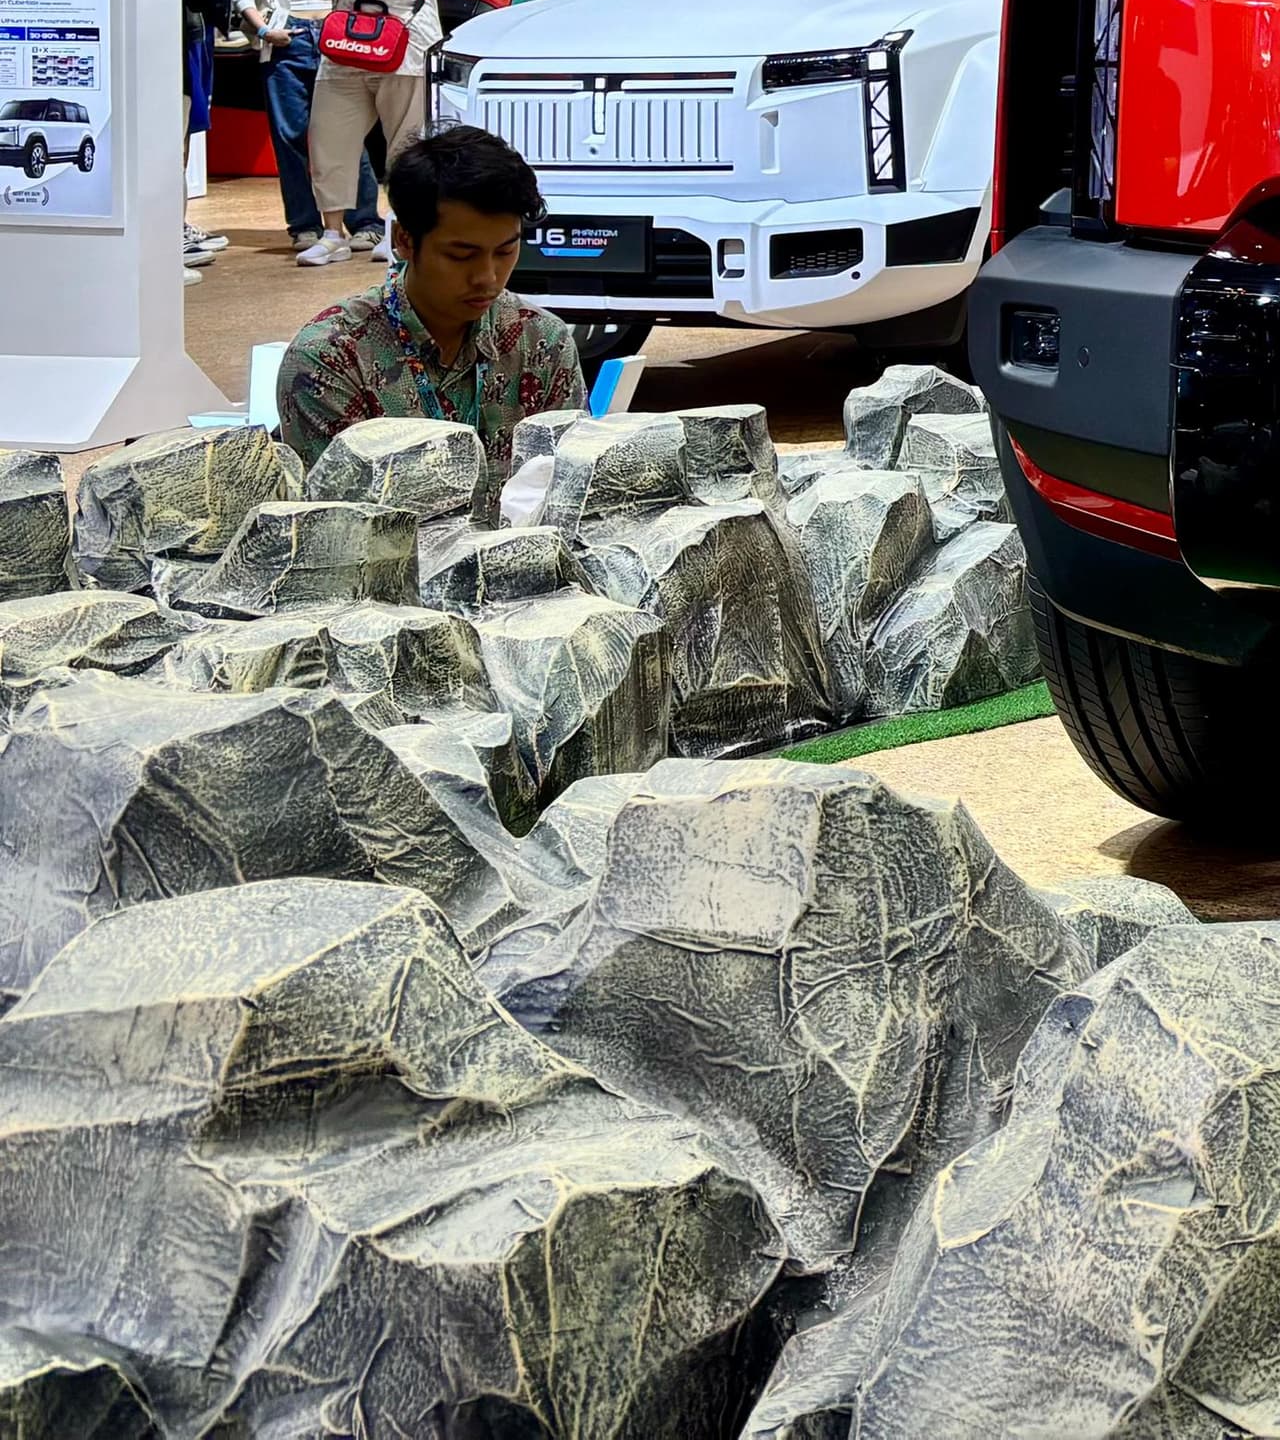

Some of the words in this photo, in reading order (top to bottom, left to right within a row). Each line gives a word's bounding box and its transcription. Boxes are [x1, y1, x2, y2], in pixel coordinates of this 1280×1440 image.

[325, 39, 371, 54] adidas
[526, 228, 566, 245] J6
[571, 229, 618, 237] PHANTOM
[571, 238, 608, 246] EDITION
